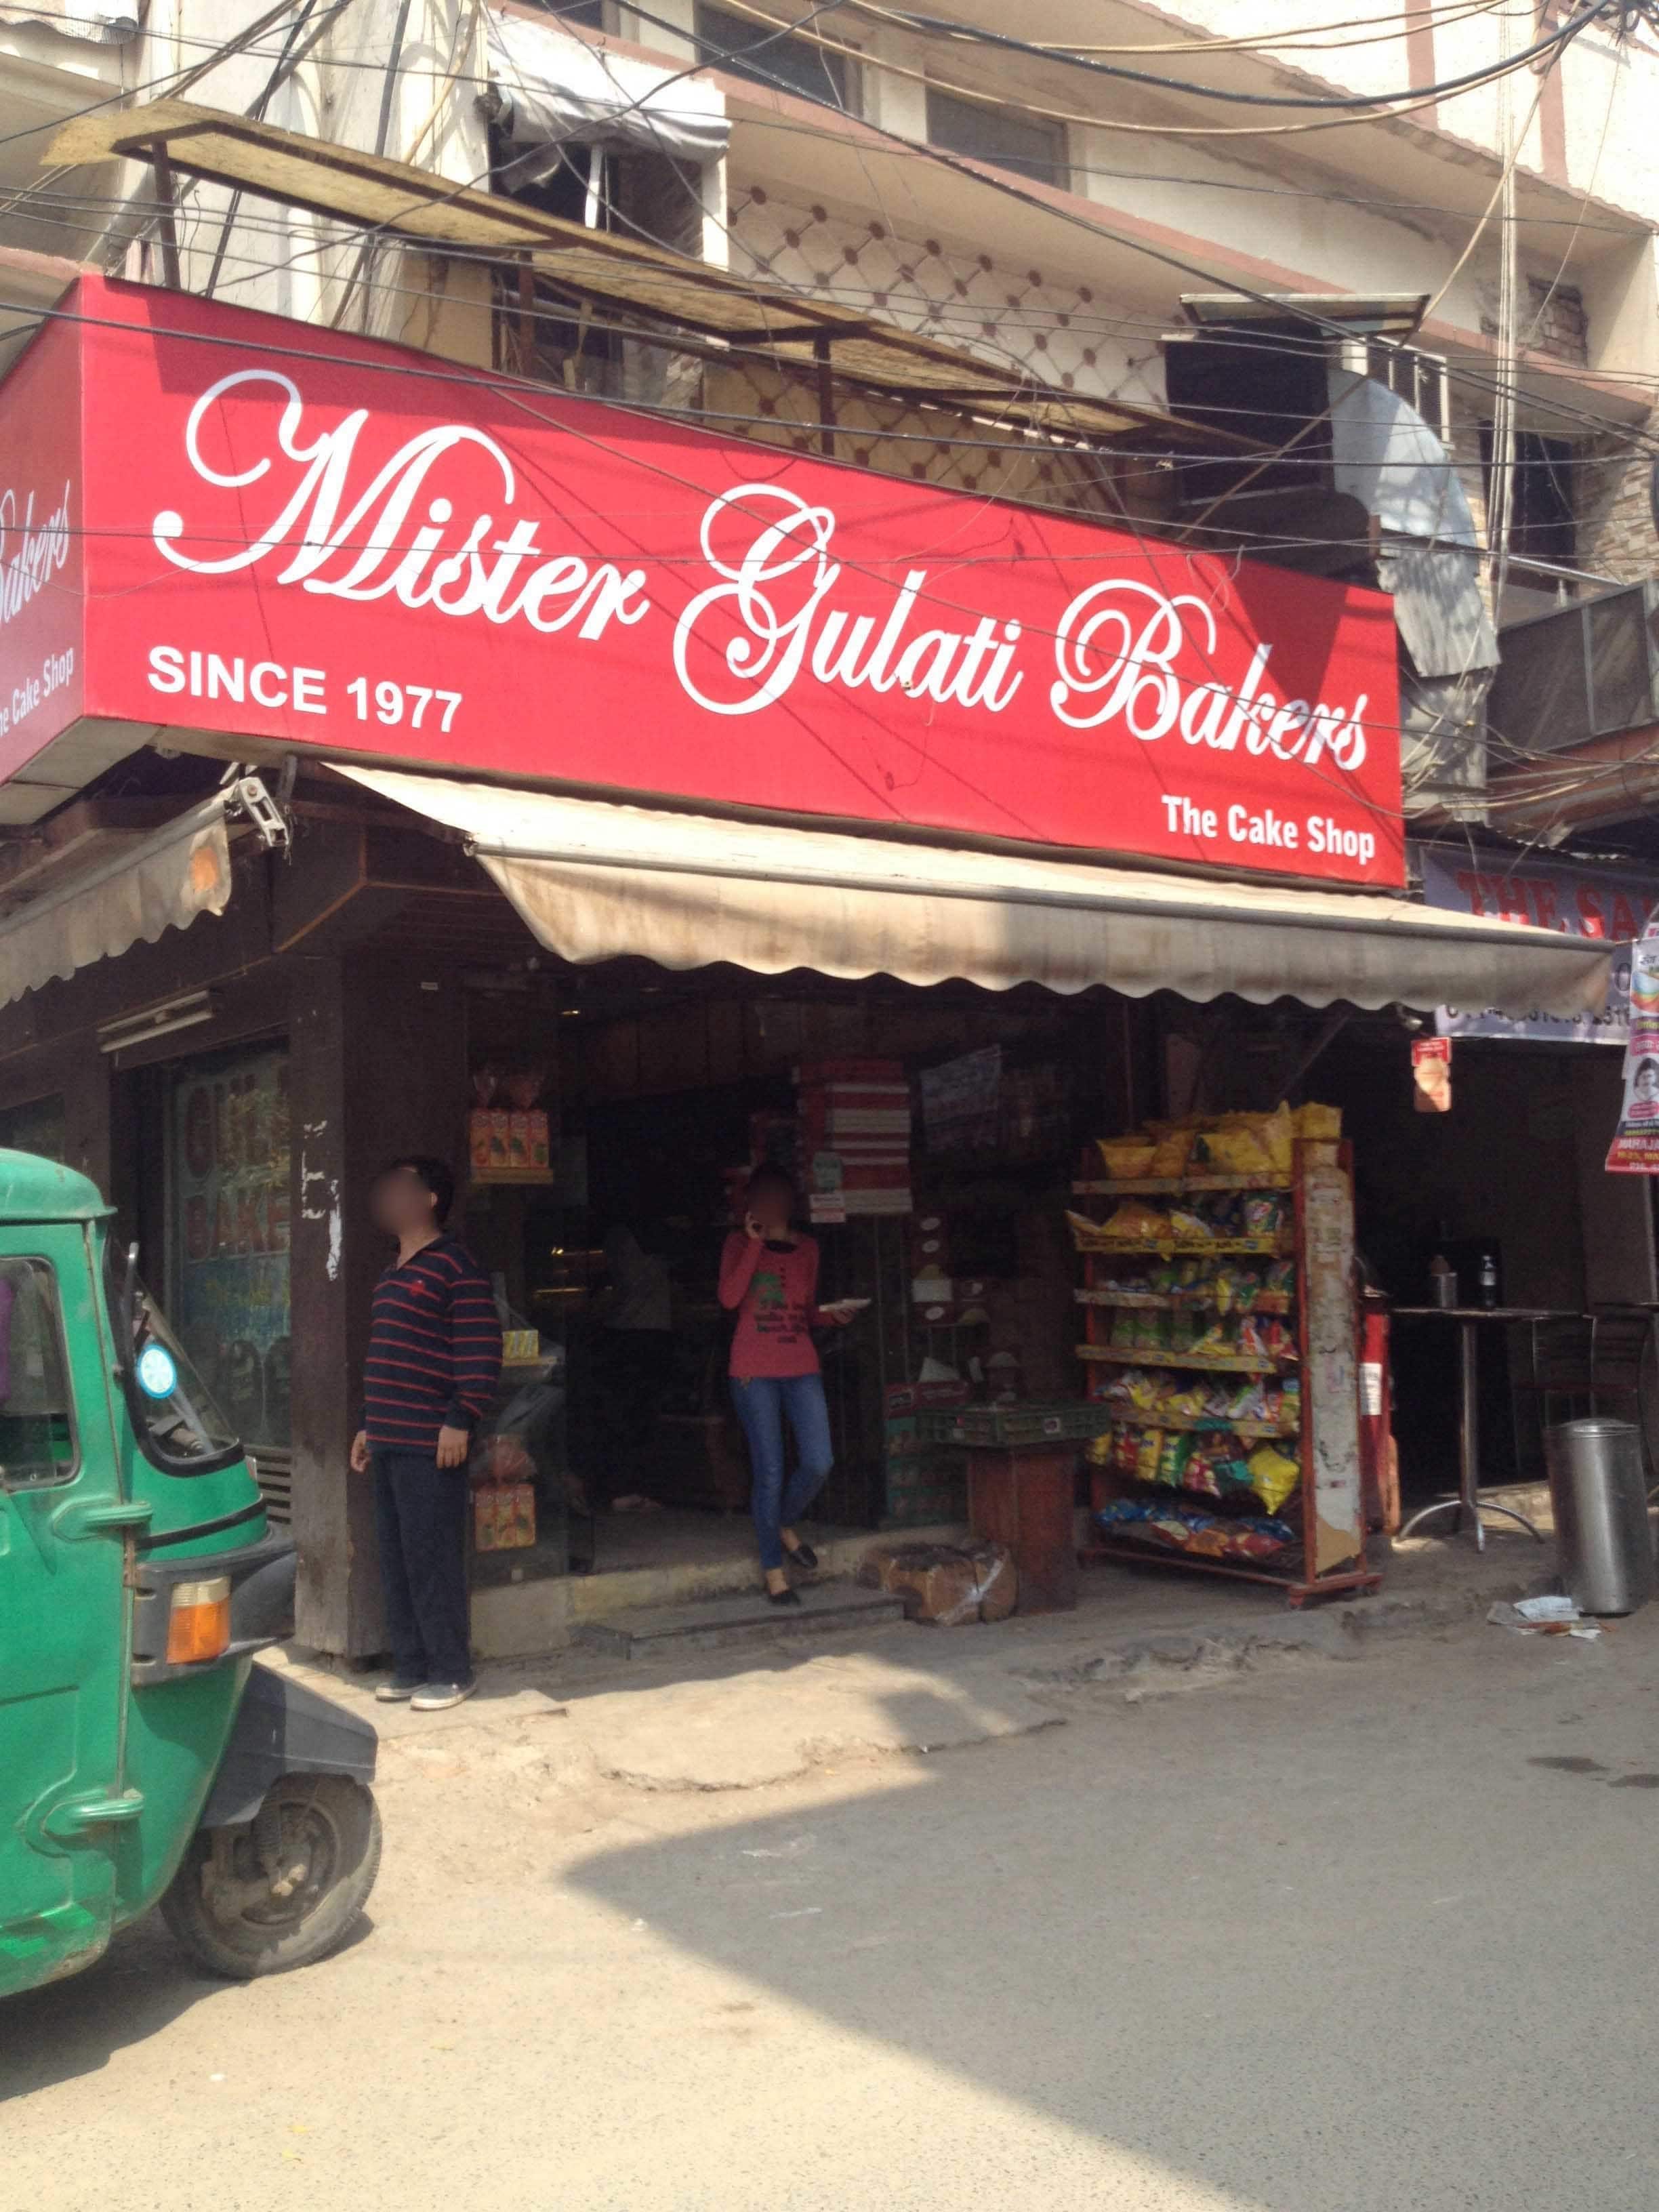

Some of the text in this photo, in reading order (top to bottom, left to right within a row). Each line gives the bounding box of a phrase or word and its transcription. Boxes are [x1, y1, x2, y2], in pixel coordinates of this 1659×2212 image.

[151, 369, 1368, 771] Mister Gulati Bakers
[12, 677, 41, 725] Cake
[43, 647, 74, 697] Shop
[147, 645, 463, 733] SINCE 1977
[1161, 794, 1375, 865] The Cake Shop
